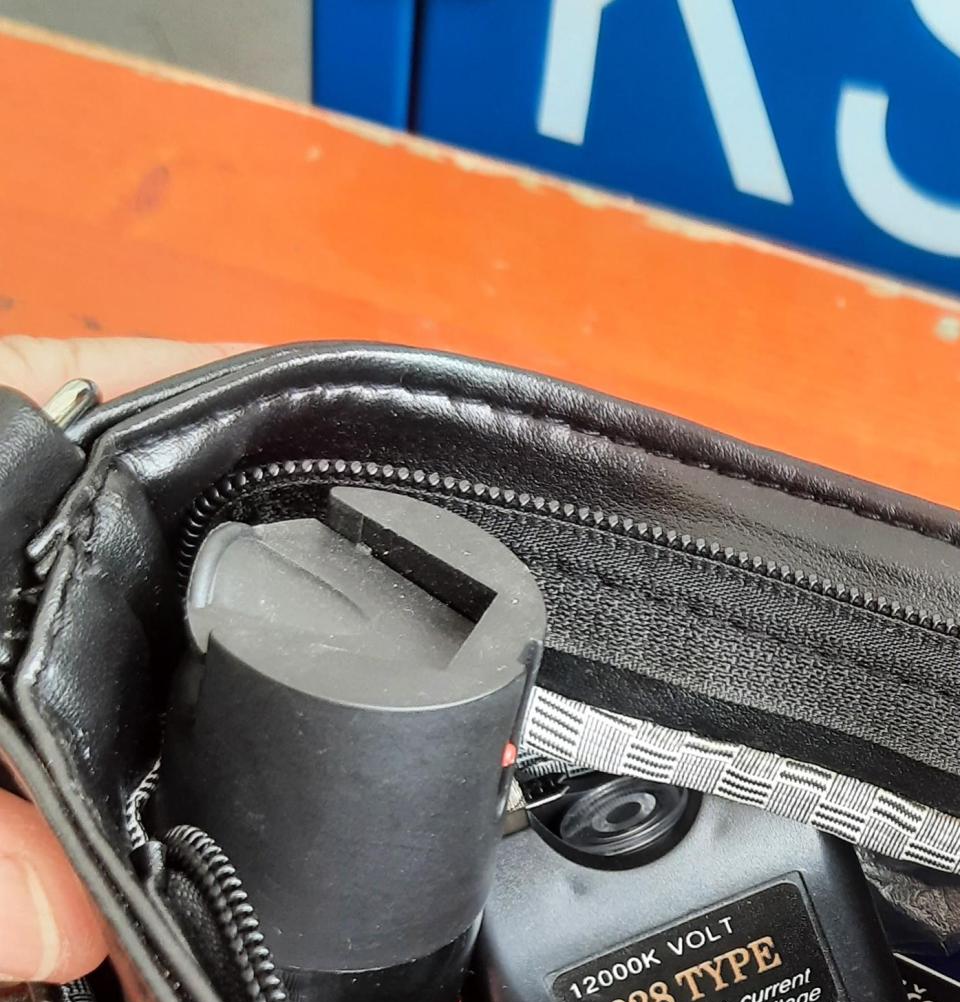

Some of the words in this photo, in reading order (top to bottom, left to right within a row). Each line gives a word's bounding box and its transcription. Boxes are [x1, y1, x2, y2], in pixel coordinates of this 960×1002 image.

[568, 949, 662, 1000] 12000K
[666, 916, 734, 957] VOLT
[674, 936, 783, 1002] TYPE
